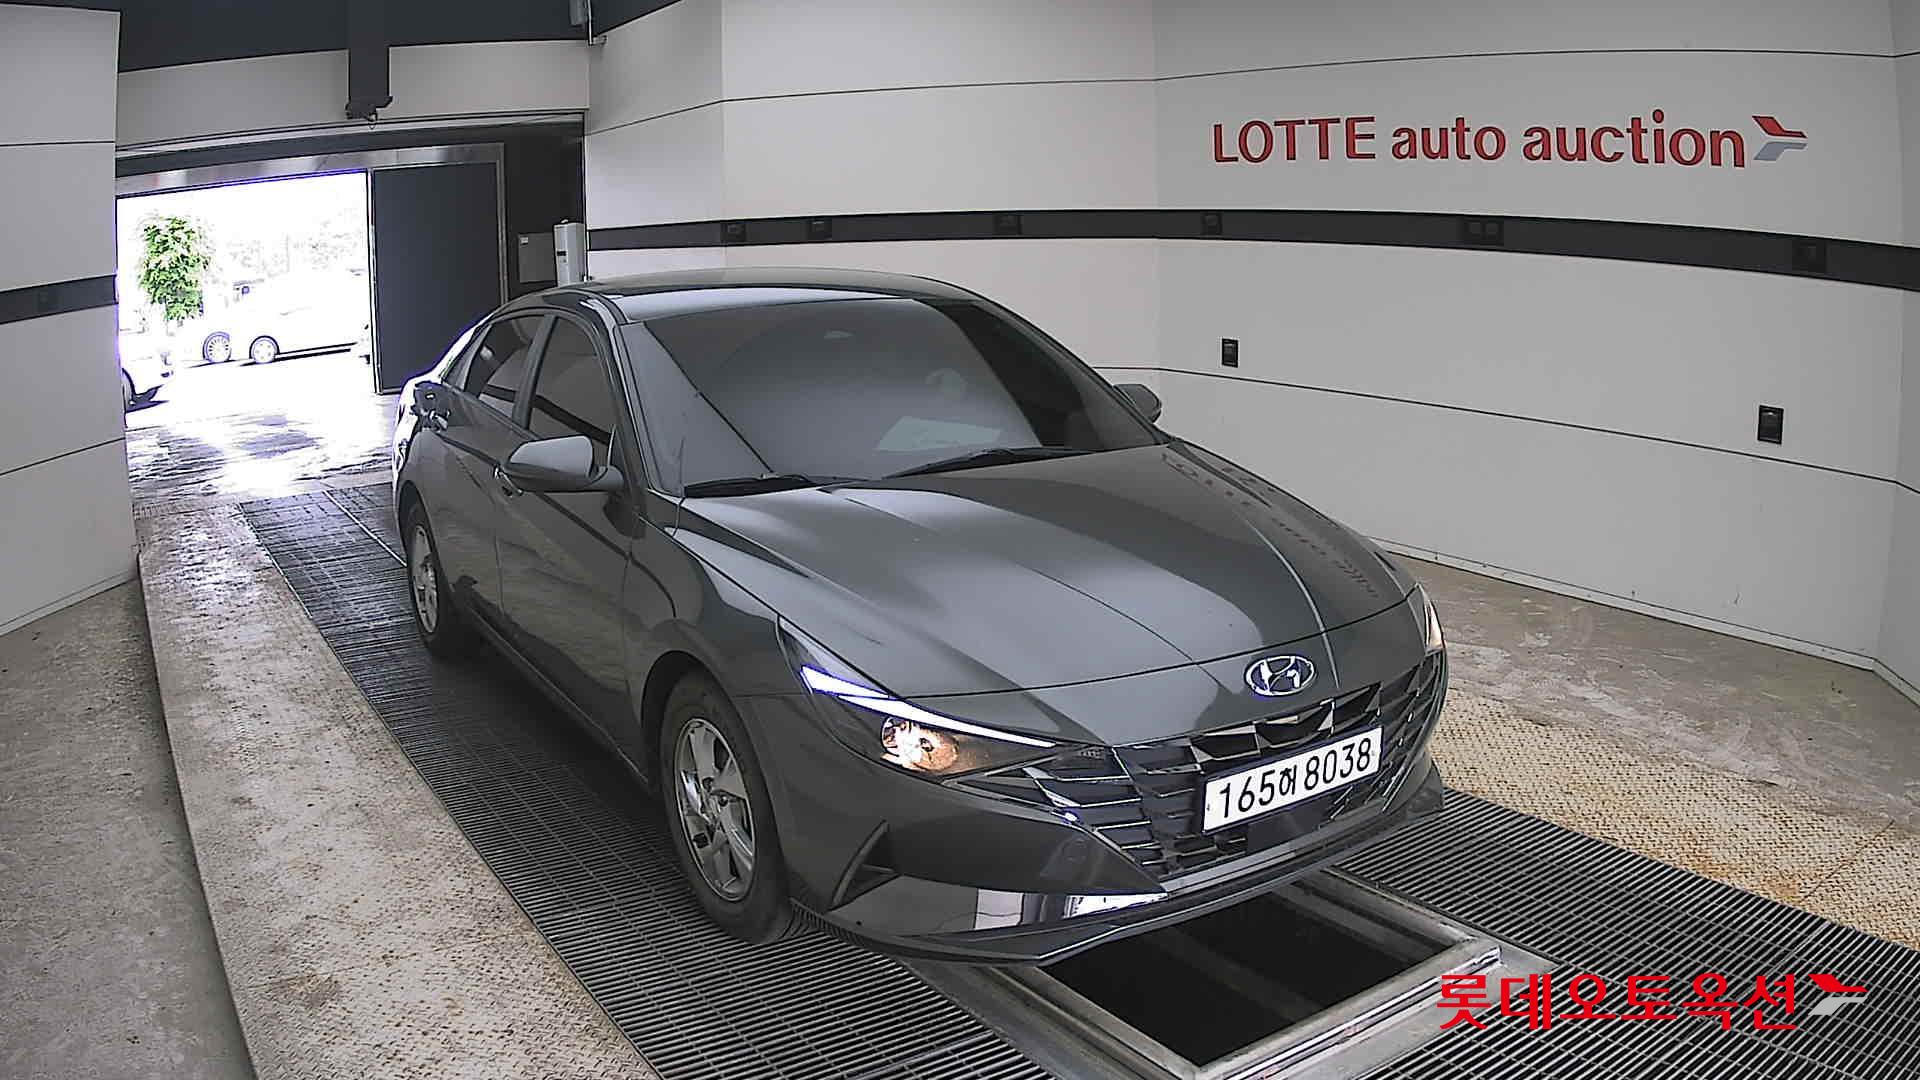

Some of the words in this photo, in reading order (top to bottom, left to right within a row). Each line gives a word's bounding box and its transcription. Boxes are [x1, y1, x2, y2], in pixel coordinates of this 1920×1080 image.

[1213, 116, 1376, 163] LOTTE
[1392, 116, 1507, 161] auto
[1522, 109, 1746, 168] auction
